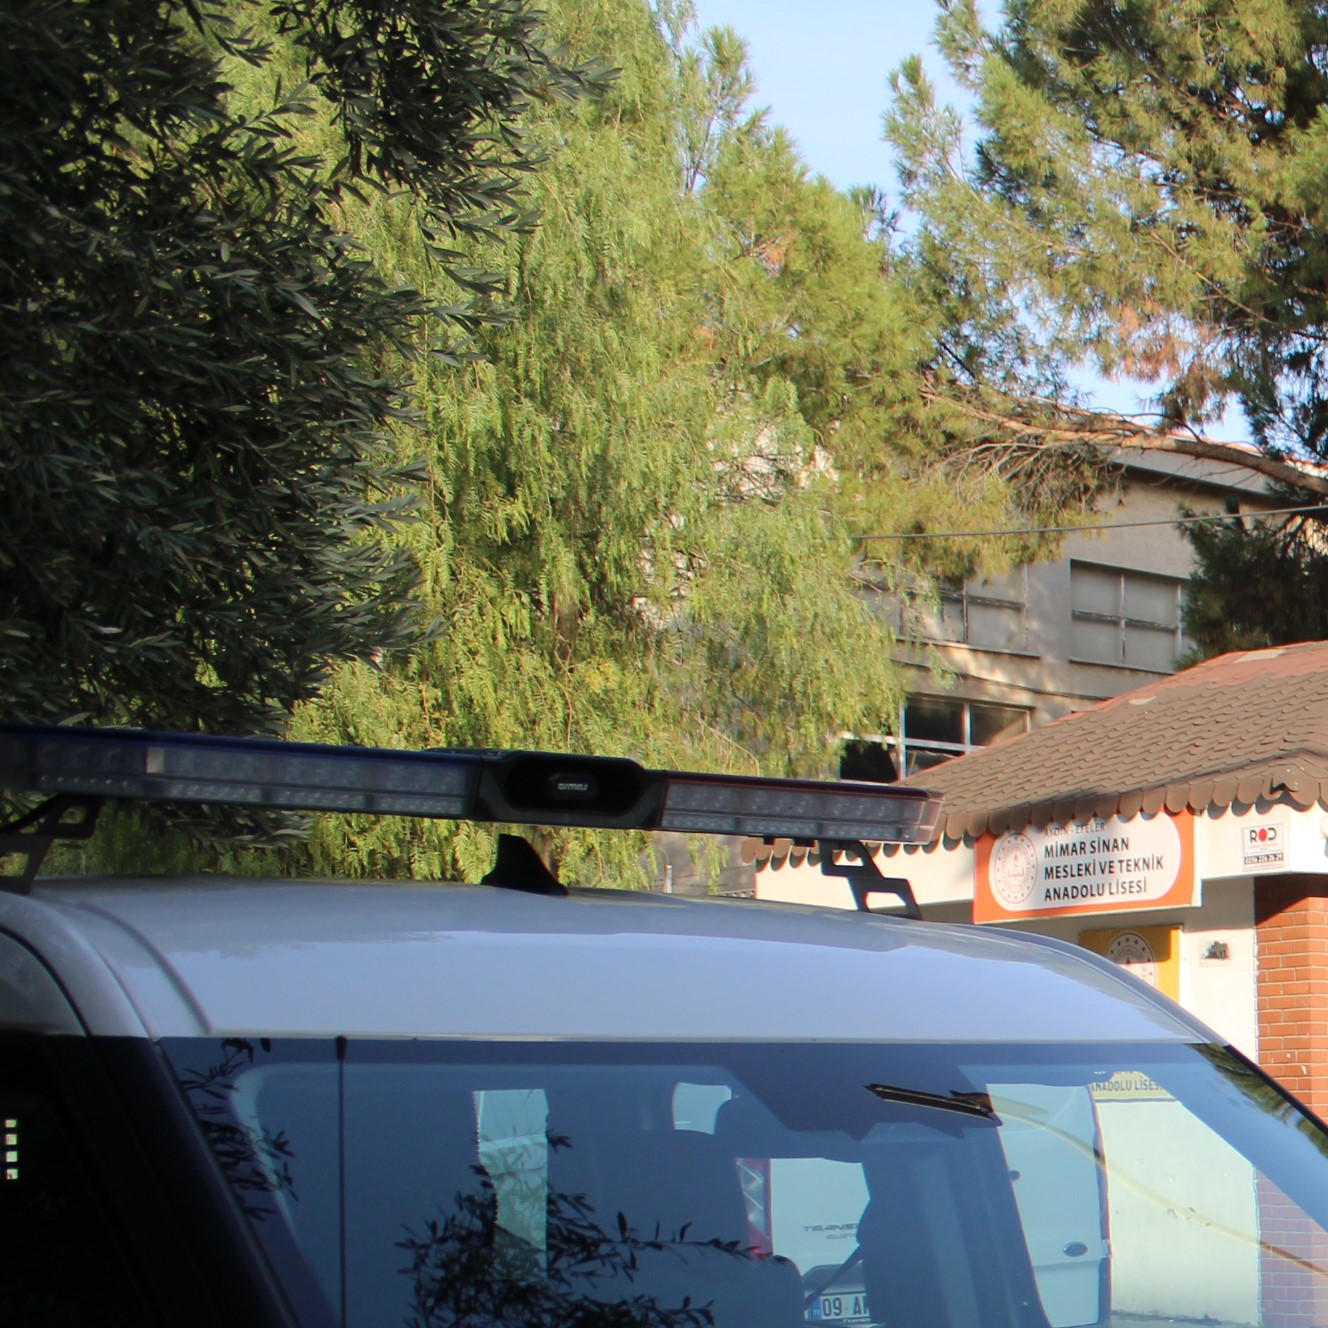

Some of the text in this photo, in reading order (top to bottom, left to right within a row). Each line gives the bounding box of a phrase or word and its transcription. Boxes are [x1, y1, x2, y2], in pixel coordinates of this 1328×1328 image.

[1076, 822, 1105, 834] EFELER
[1044, 836, 1130, 859] MİMAR SİNAN
[1044, 858, 1096, 881] MESLEKİ
[1099, 860, 1115, 875] VE
[1118, 852, 1164, 874] TEKNİK
[1044, 877, 1147, 902] ANADOLU LİSESİ
[823, 1297, 842, 1317] 09
